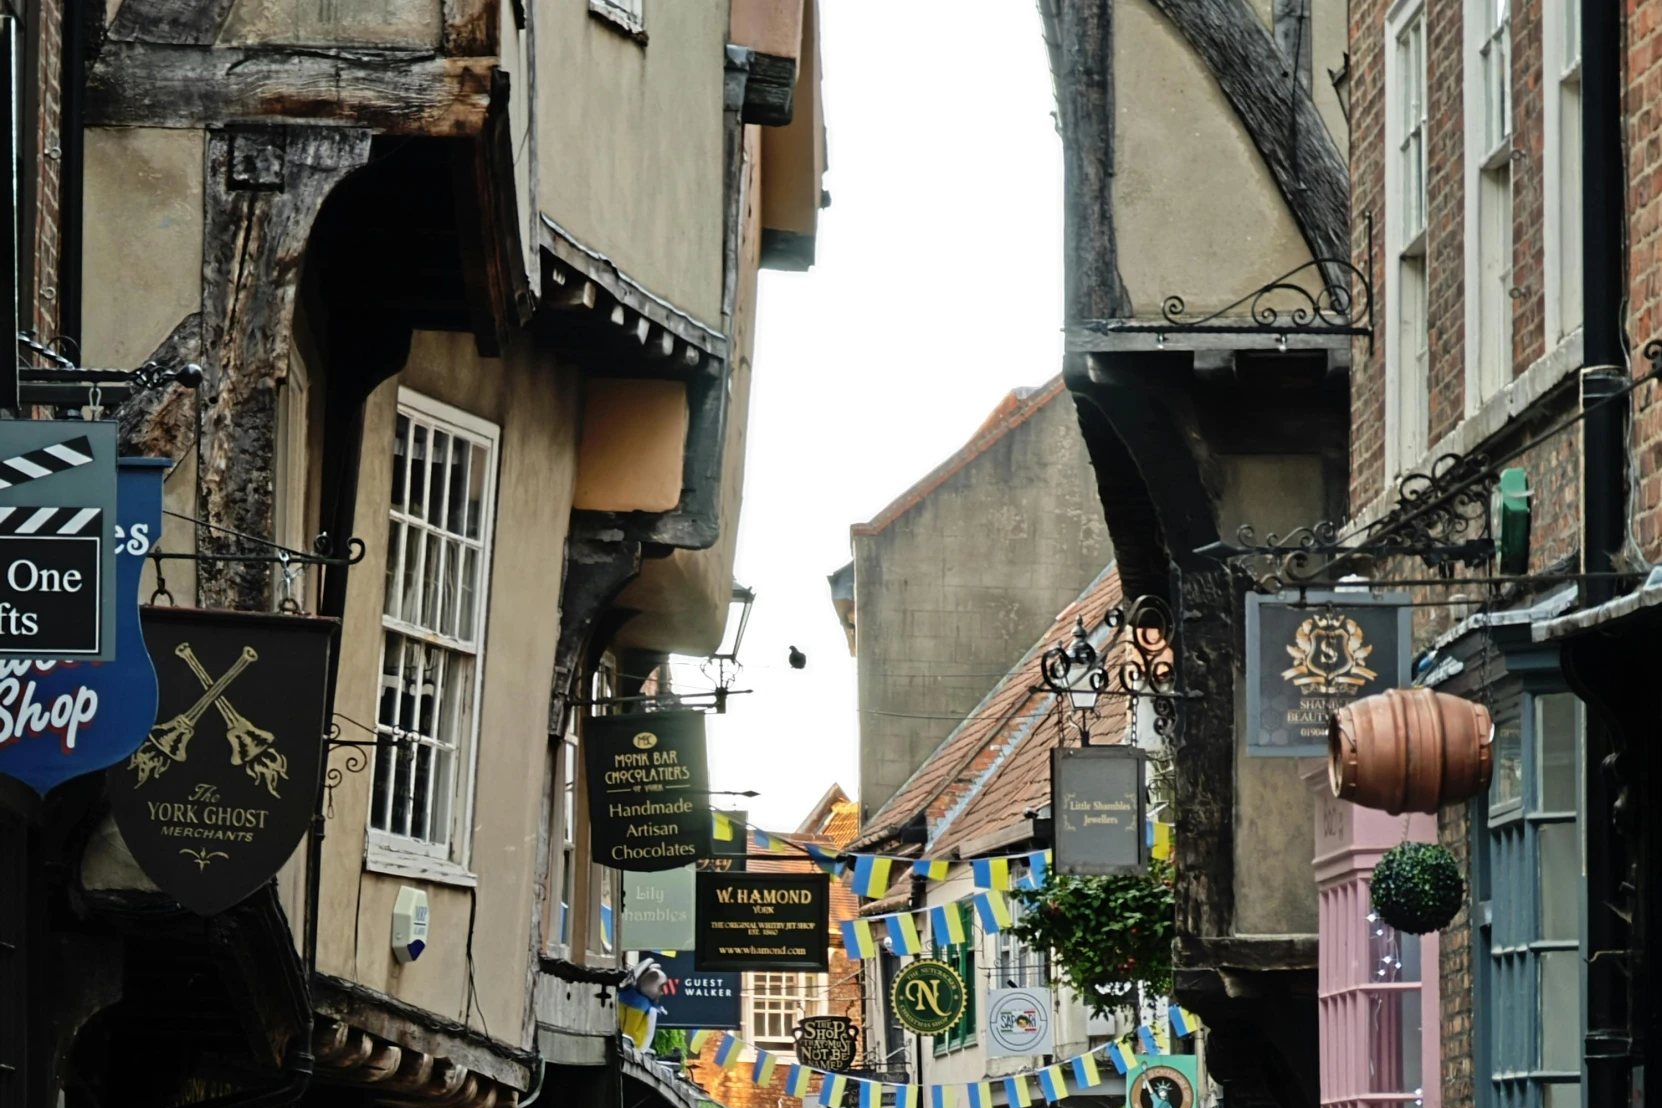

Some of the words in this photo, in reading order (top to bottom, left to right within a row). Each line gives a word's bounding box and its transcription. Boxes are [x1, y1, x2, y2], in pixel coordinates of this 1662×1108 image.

[8, 559, 83, 593] One
[0, 677, 99, 749] Shop
[614, 753, 650, 768] MONK
[653, 750, 678, 766] BAR
[604, 766, 691, 785] CHOCOLATIERS
[188, 783, 220, 803] The
[147, 800, 200, 824] YORK
[203, 805, 269, 829] GHOST
[609, 798, 693, 818] Handmade
[1070, 801, 1092, 811] Little
[1093, 801, 1131, 811] Shambles
[1083, 814, 1119, 827] Jewellers
[160, 825, 255, 843] MERCHANTS
[626, 822, 679, 838] Artisan
[611, 842, 696, 861] Chocolates
[636, 885, 665, 903] Lily
[716, 886, 735, 903] W.
[737, 889, 813, 904] HAMOND
[752, 905, 775, 914] YORK
[718, 945, 807, 955] www.whamond.com
[684, 978, 724, 987] GUEST
[684, 988, 733, 997] WALKER
[905, 979, 953, 1018] N
[804, 1021, 846, 1040] SHOP
[815, 1019, 834, 1030] THE
[801, 1047, 829, 1062] NOT
[830, 1049, 849, 1061] BE
